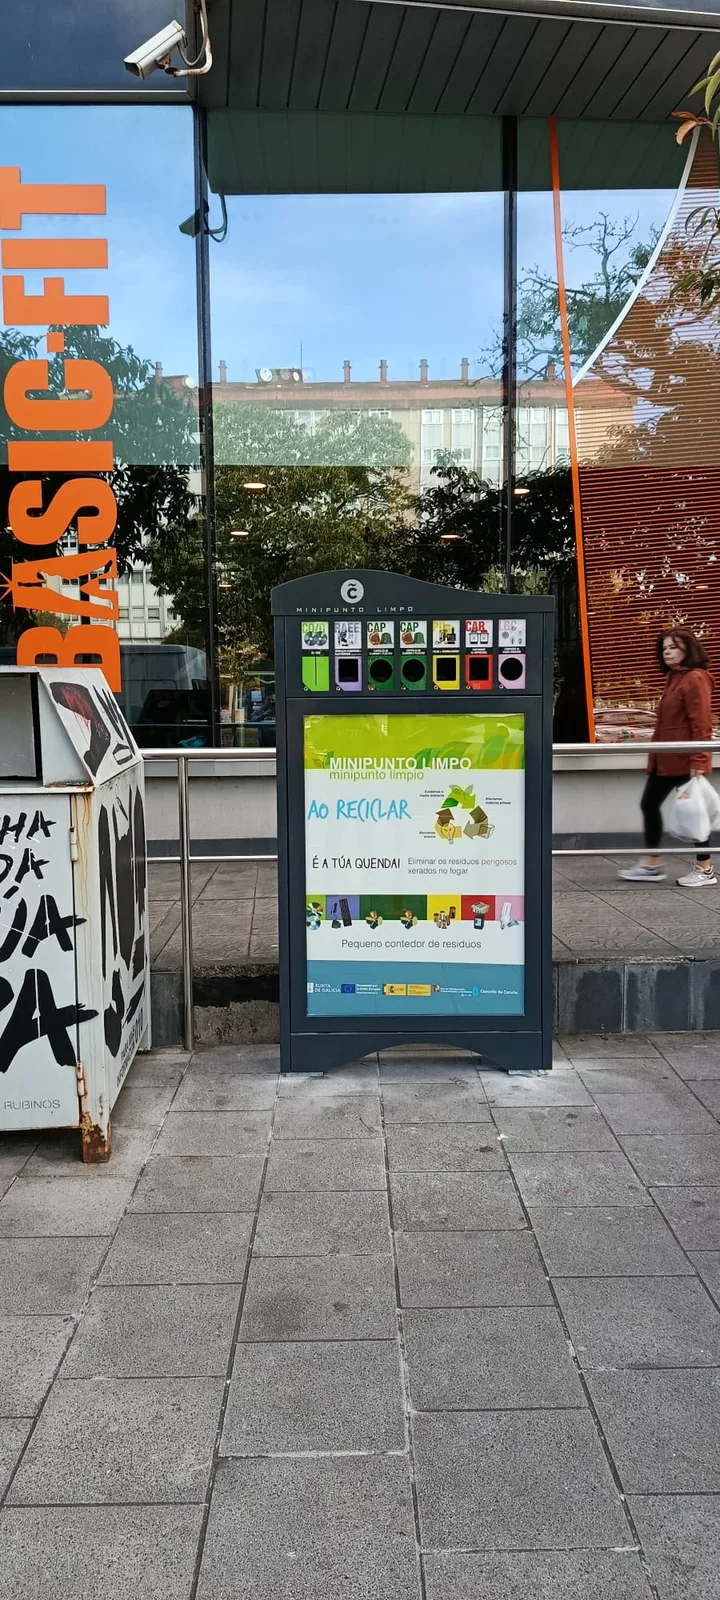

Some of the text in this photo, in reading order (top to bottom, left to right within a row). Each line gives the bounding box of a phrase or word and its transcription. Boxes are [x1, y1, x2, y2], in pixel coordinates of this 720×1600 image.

[334, 622, 360, 633] RAEE
[367, 622, 387, 633] CAP
[400, 621, 419, 633] CAP
[329, 757, 472, 770] MINIPUNTO LIMPO
[329, 769, 424, 782] minipunto limpio
[307, 798, 412, 822] AO RECICLAR
[312, 855, 319, 868] É
[322, 858, 329, 868] A
[331, 855, 352, 868] TÚA
[407, 857, 436, 865] Eliminar
[481, 858, 517, 868] perigosos
[407, 867, 437, 875] xerados
[449, 867, 468, 876] fogar
[341, 939, 482, 950] Pequeno contedor de residuos
[4, 1099, 60, 1110] RUBINOS
